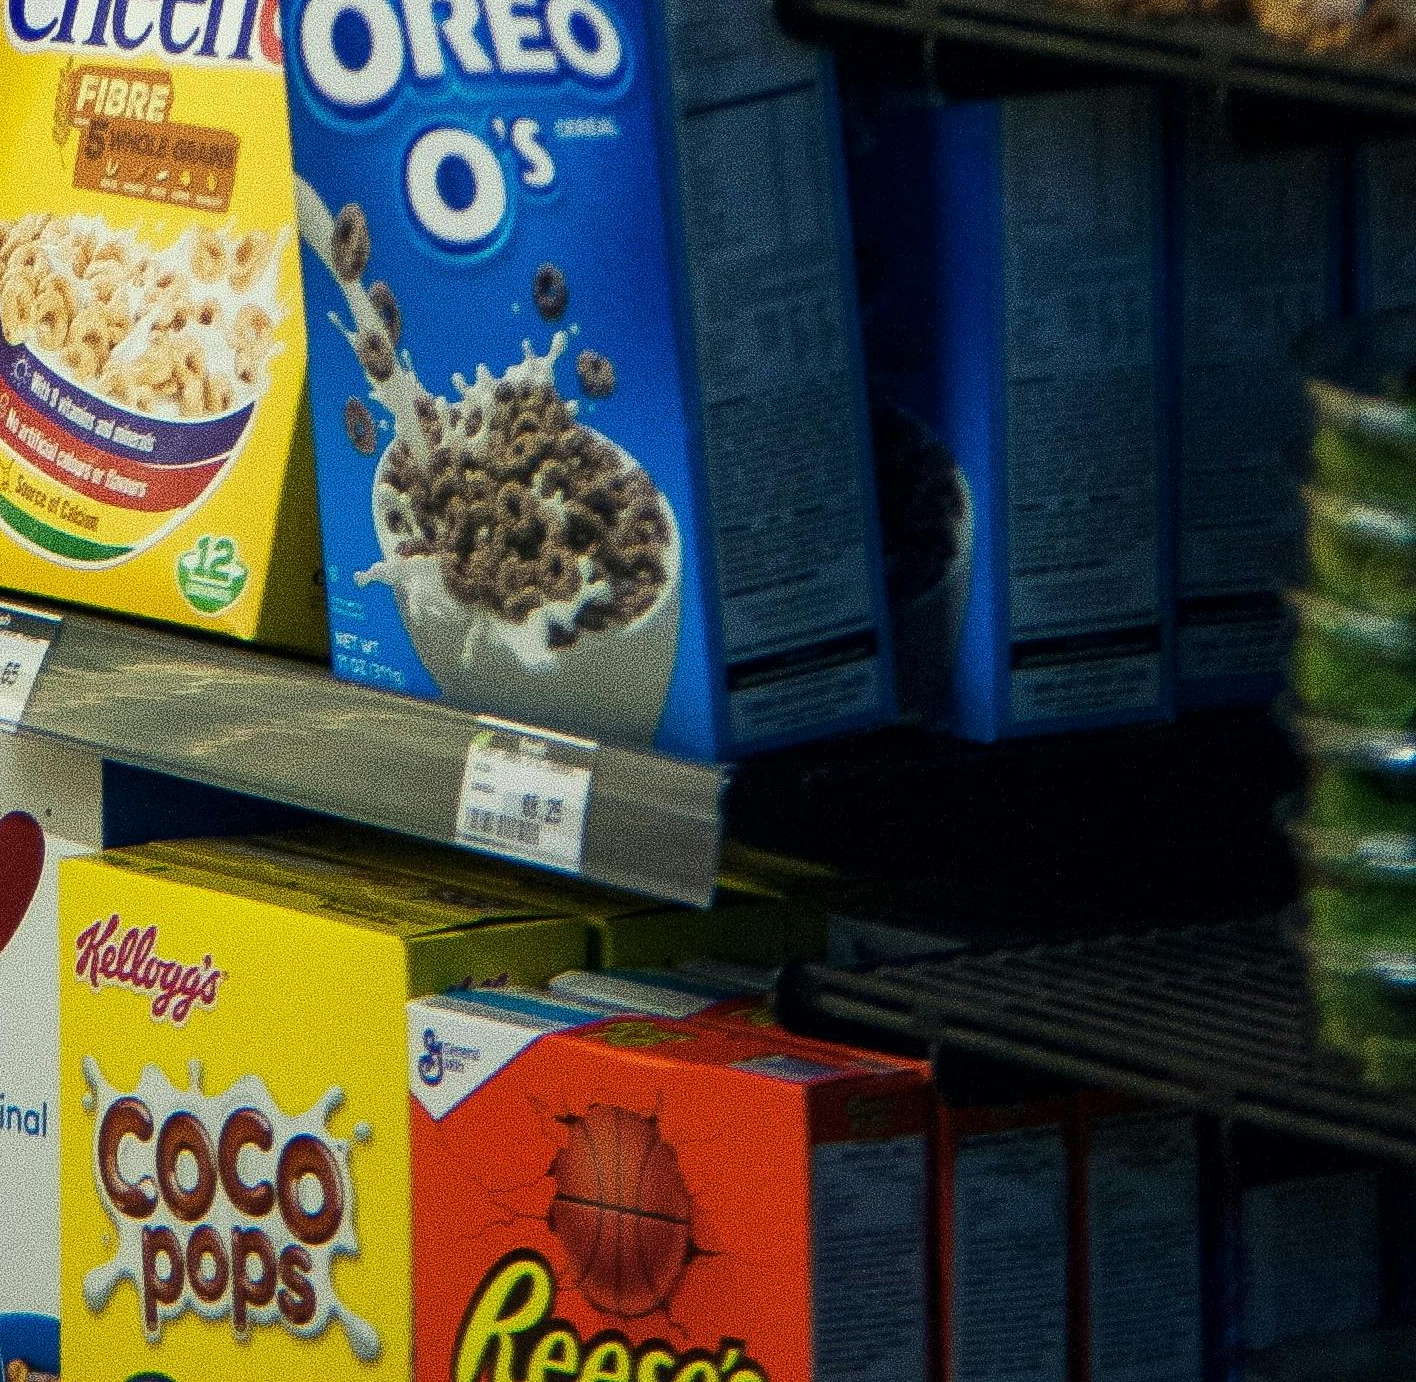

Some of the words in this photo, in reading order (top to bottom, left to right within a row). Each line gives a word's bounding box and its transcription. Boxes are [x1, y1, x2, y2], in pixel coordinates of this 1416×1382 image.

[75, 74, 171, 123] FIBRE
[83, 120, 109, 161] 5
[109, 129, 168, 160] WHOLE
[172, 137, 236, 168] GRAINS
[14, 474, 49, 510] Source
[60, 498, 101, 532] Calcium
[193, 535, 236, 583] 12
[75, 913, 222, 1023] Kellogg's
